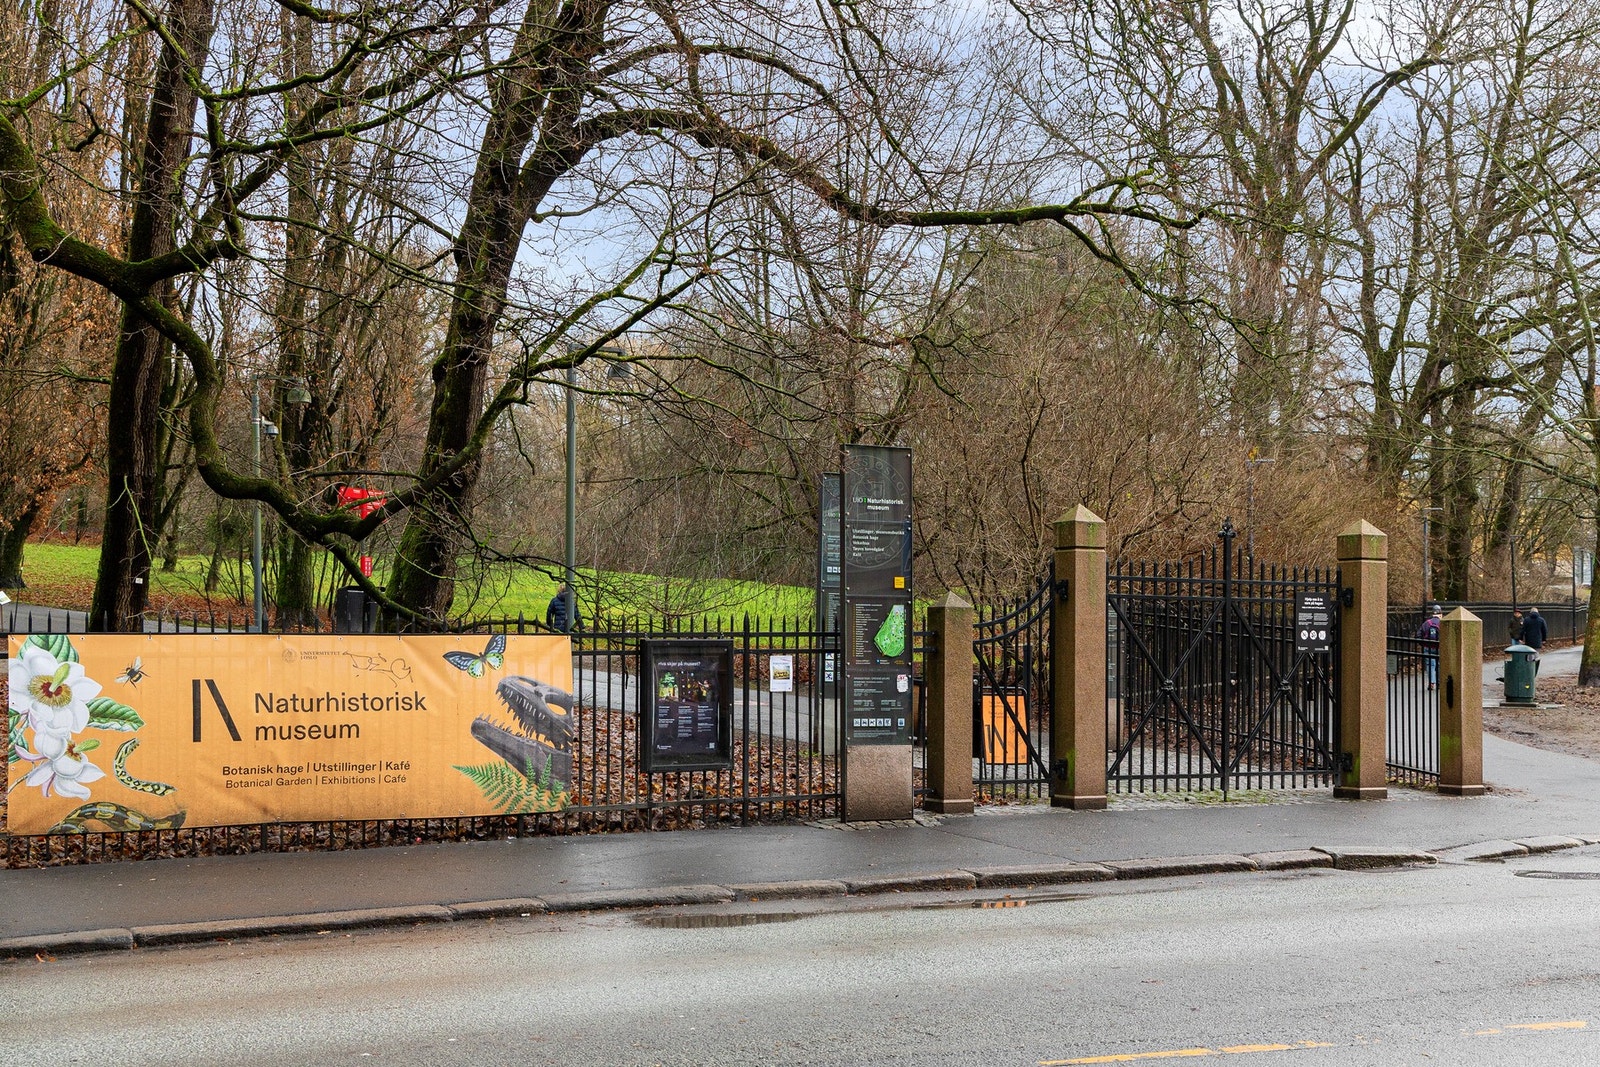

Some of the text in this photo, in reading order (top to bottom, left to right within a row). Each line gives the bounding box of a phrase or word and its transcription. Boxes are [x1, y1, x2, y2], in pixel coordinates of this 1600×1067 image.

[255, 691, 427, 713] Naturhistorisk
[255, 723, 360, 741] museum
[222, 765, 273, 776] Botanisk
[276, 764, 304, 775] hage
[313, 762, 377, 773] Utstillinger
[385, 760, 411, 771] Kafé
[225, 778, 273, 789] Botanical
[276, 777, 312, 787] Garden
[321, 775, 376, 785] Exhibitions
[384, 774, 407, 784] Café
